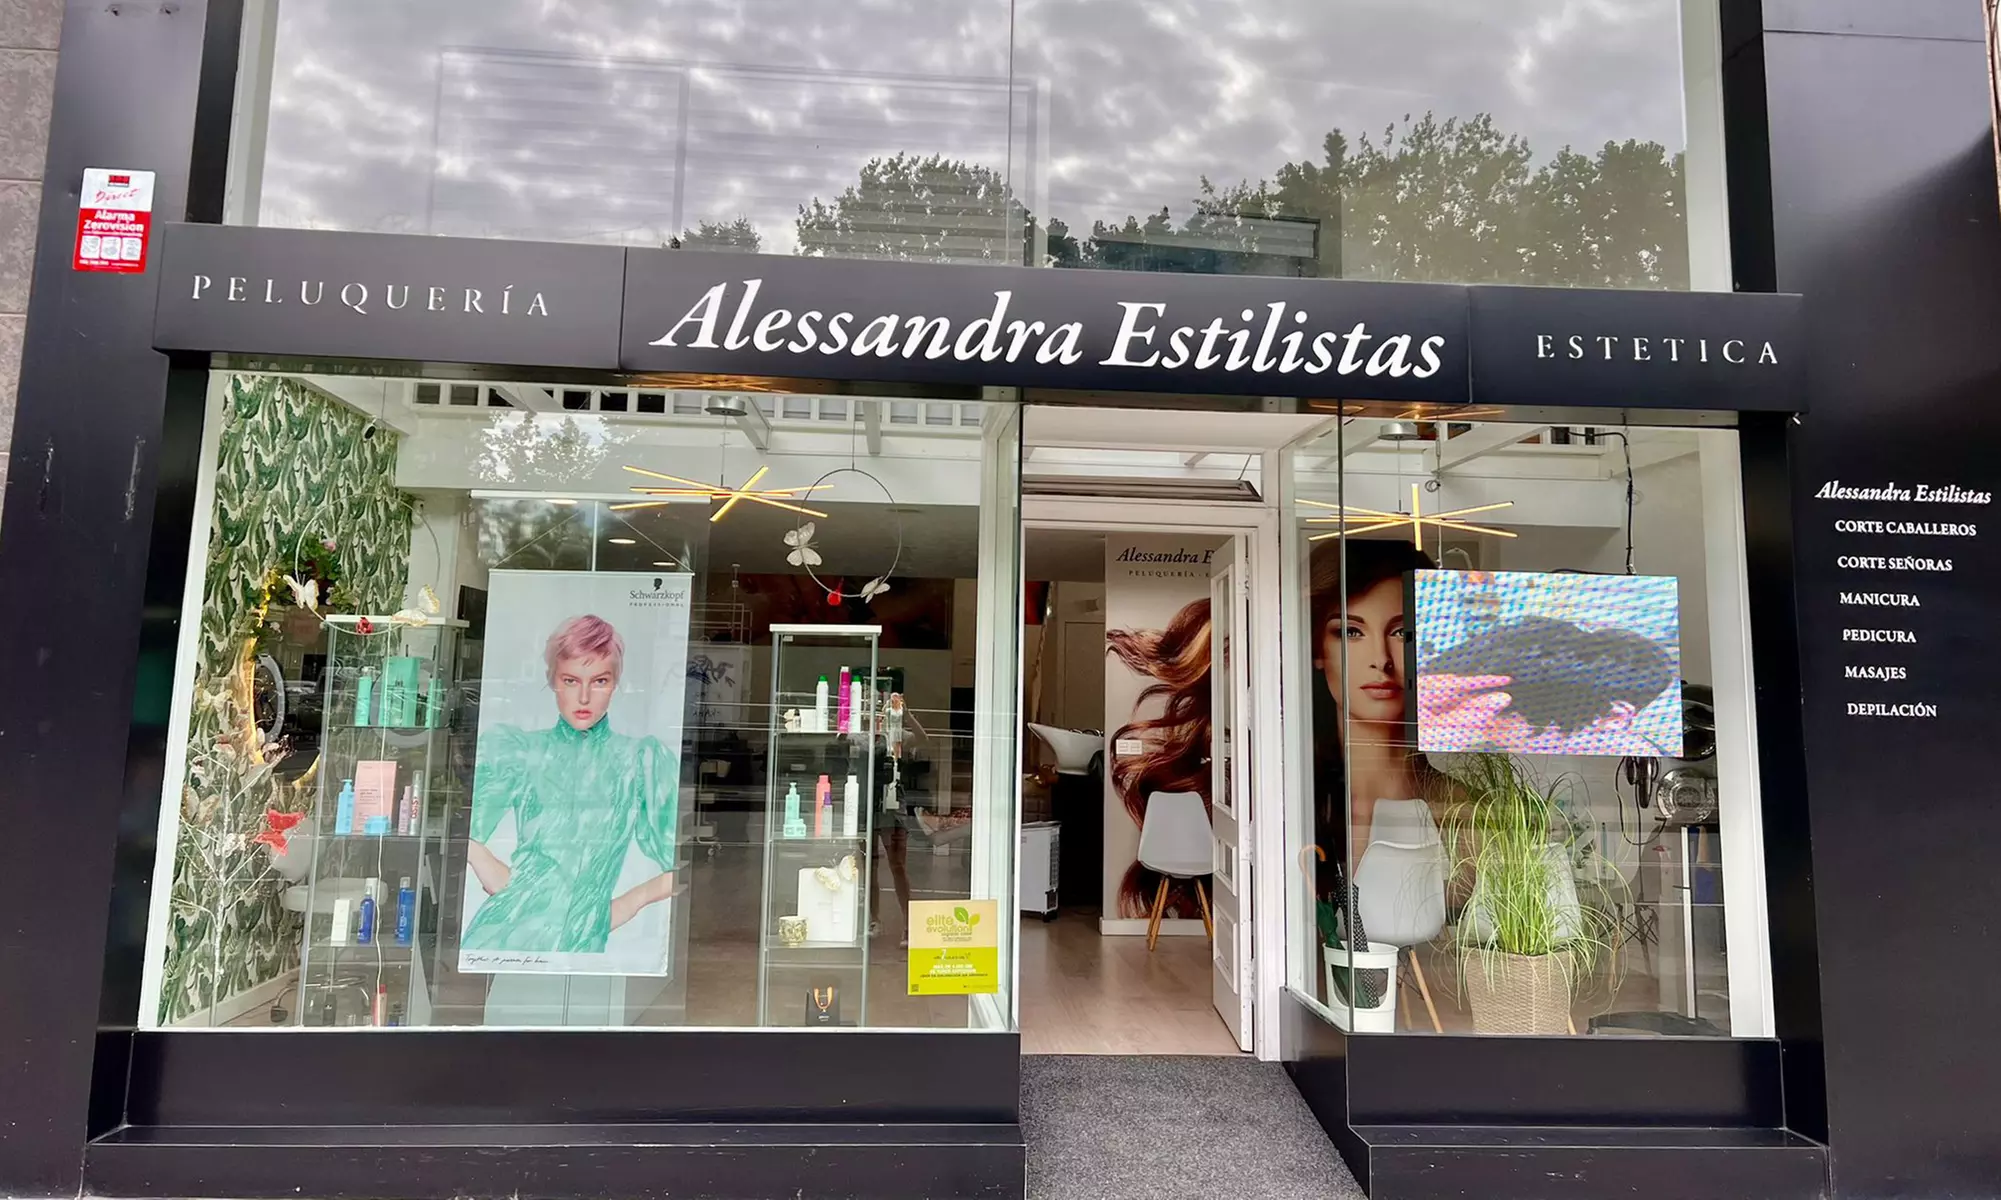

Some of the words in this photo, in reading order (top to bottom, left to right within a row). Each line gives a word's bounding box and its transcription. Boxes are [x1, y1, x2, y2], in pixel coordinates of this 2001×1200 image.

[94, 210, 135, 222] Alarma
[84, 220, 144, 232] Zerovision
[191, 275, 549, 317] PELUQUERÍA
[648, 278, 1083, 366] Alessandra
[1098, 301, 1446, 379] Estilistas
[1537, 334, 1778, 364] ESTETICA
[1814, 480, 1911, 502] Alessandra
[1913, 484, 1992, 504] Estilistas
[1835, 519, 1884, 534] CORTE
[1886, 521, 1977, 537] CABALLEROS
[1116, 546, 1199, 564] Alessandra
[1837, 555, 1886, 570] CORTE
[1888, 556, 1953, 571] SEÑORAS
[1128, 570, 1195, 578] PELUQUERÍA
[629, 591, 684, 602] Schwarzkopf
[1839, 592, 1921, 607] MANICURA
[1842, 629, 1917, 643] PEDICURA
[1844, 666, 1907, 682] MASAJES
[1847, 702, 1937, 717] DEPILACIÓN
[926, 914, 954, 926] elite
